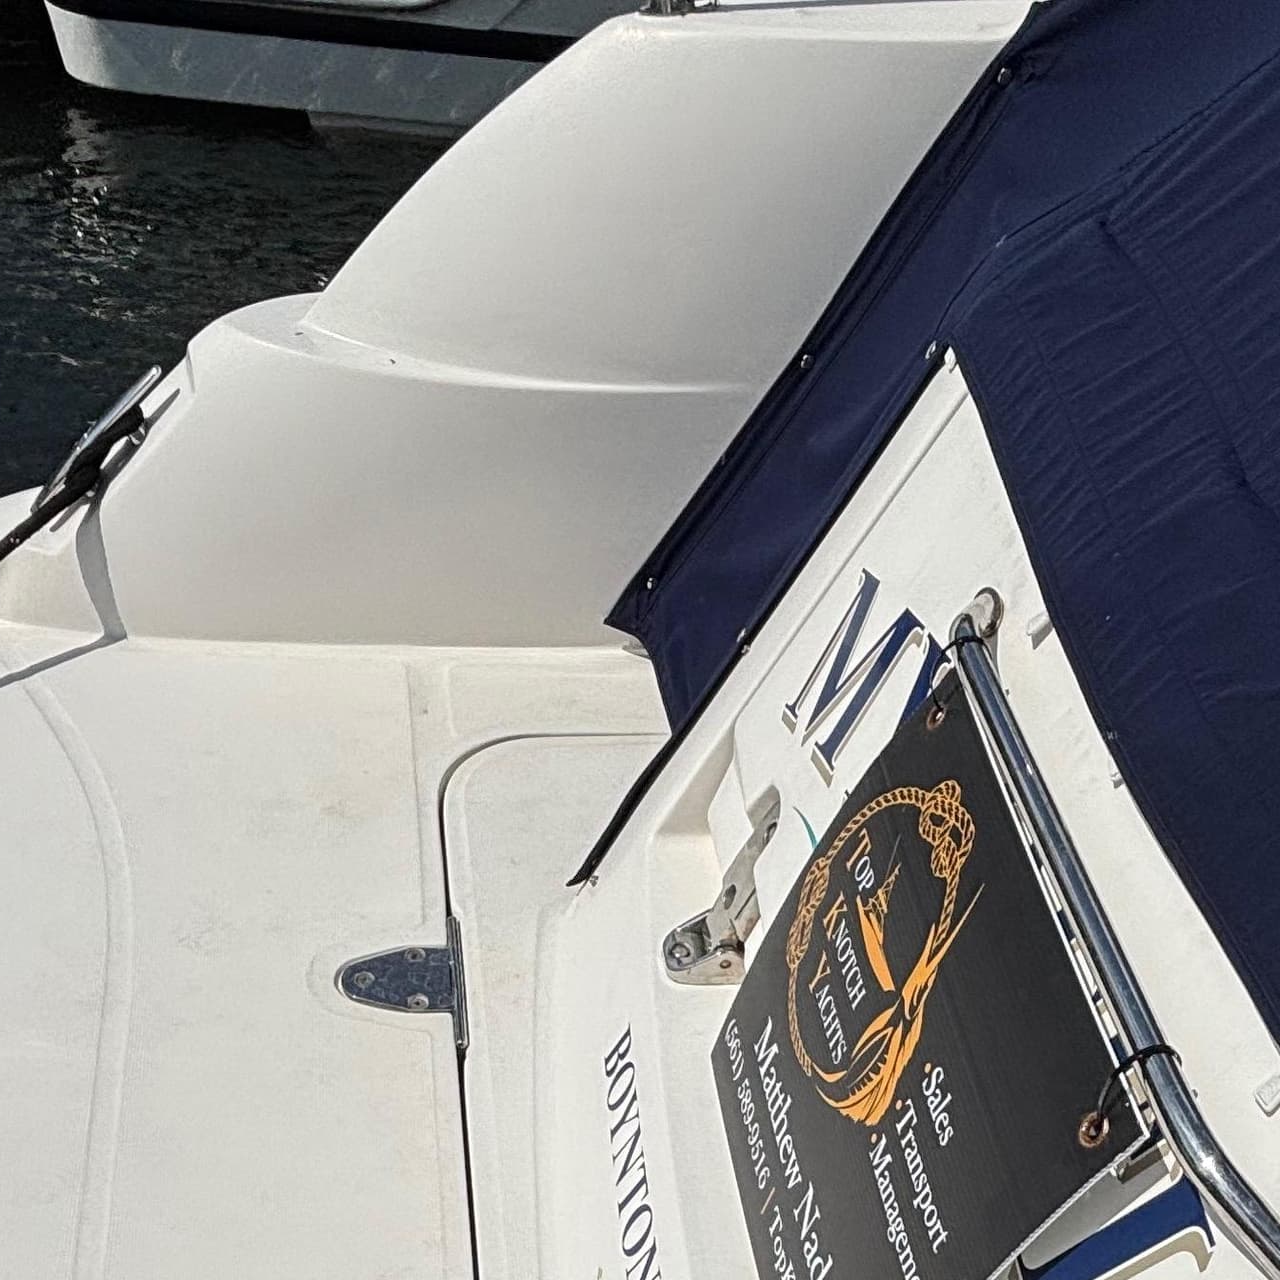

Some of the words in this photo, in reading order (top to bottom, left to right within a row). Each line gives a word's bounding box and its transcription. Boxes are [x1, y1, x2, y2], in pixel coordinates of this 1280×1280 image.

[724, 1018, 745, 1081] (561)
[737, 1078, 770, 1190] 589-9516
[754, 1015, 802, 1189] Matthew
